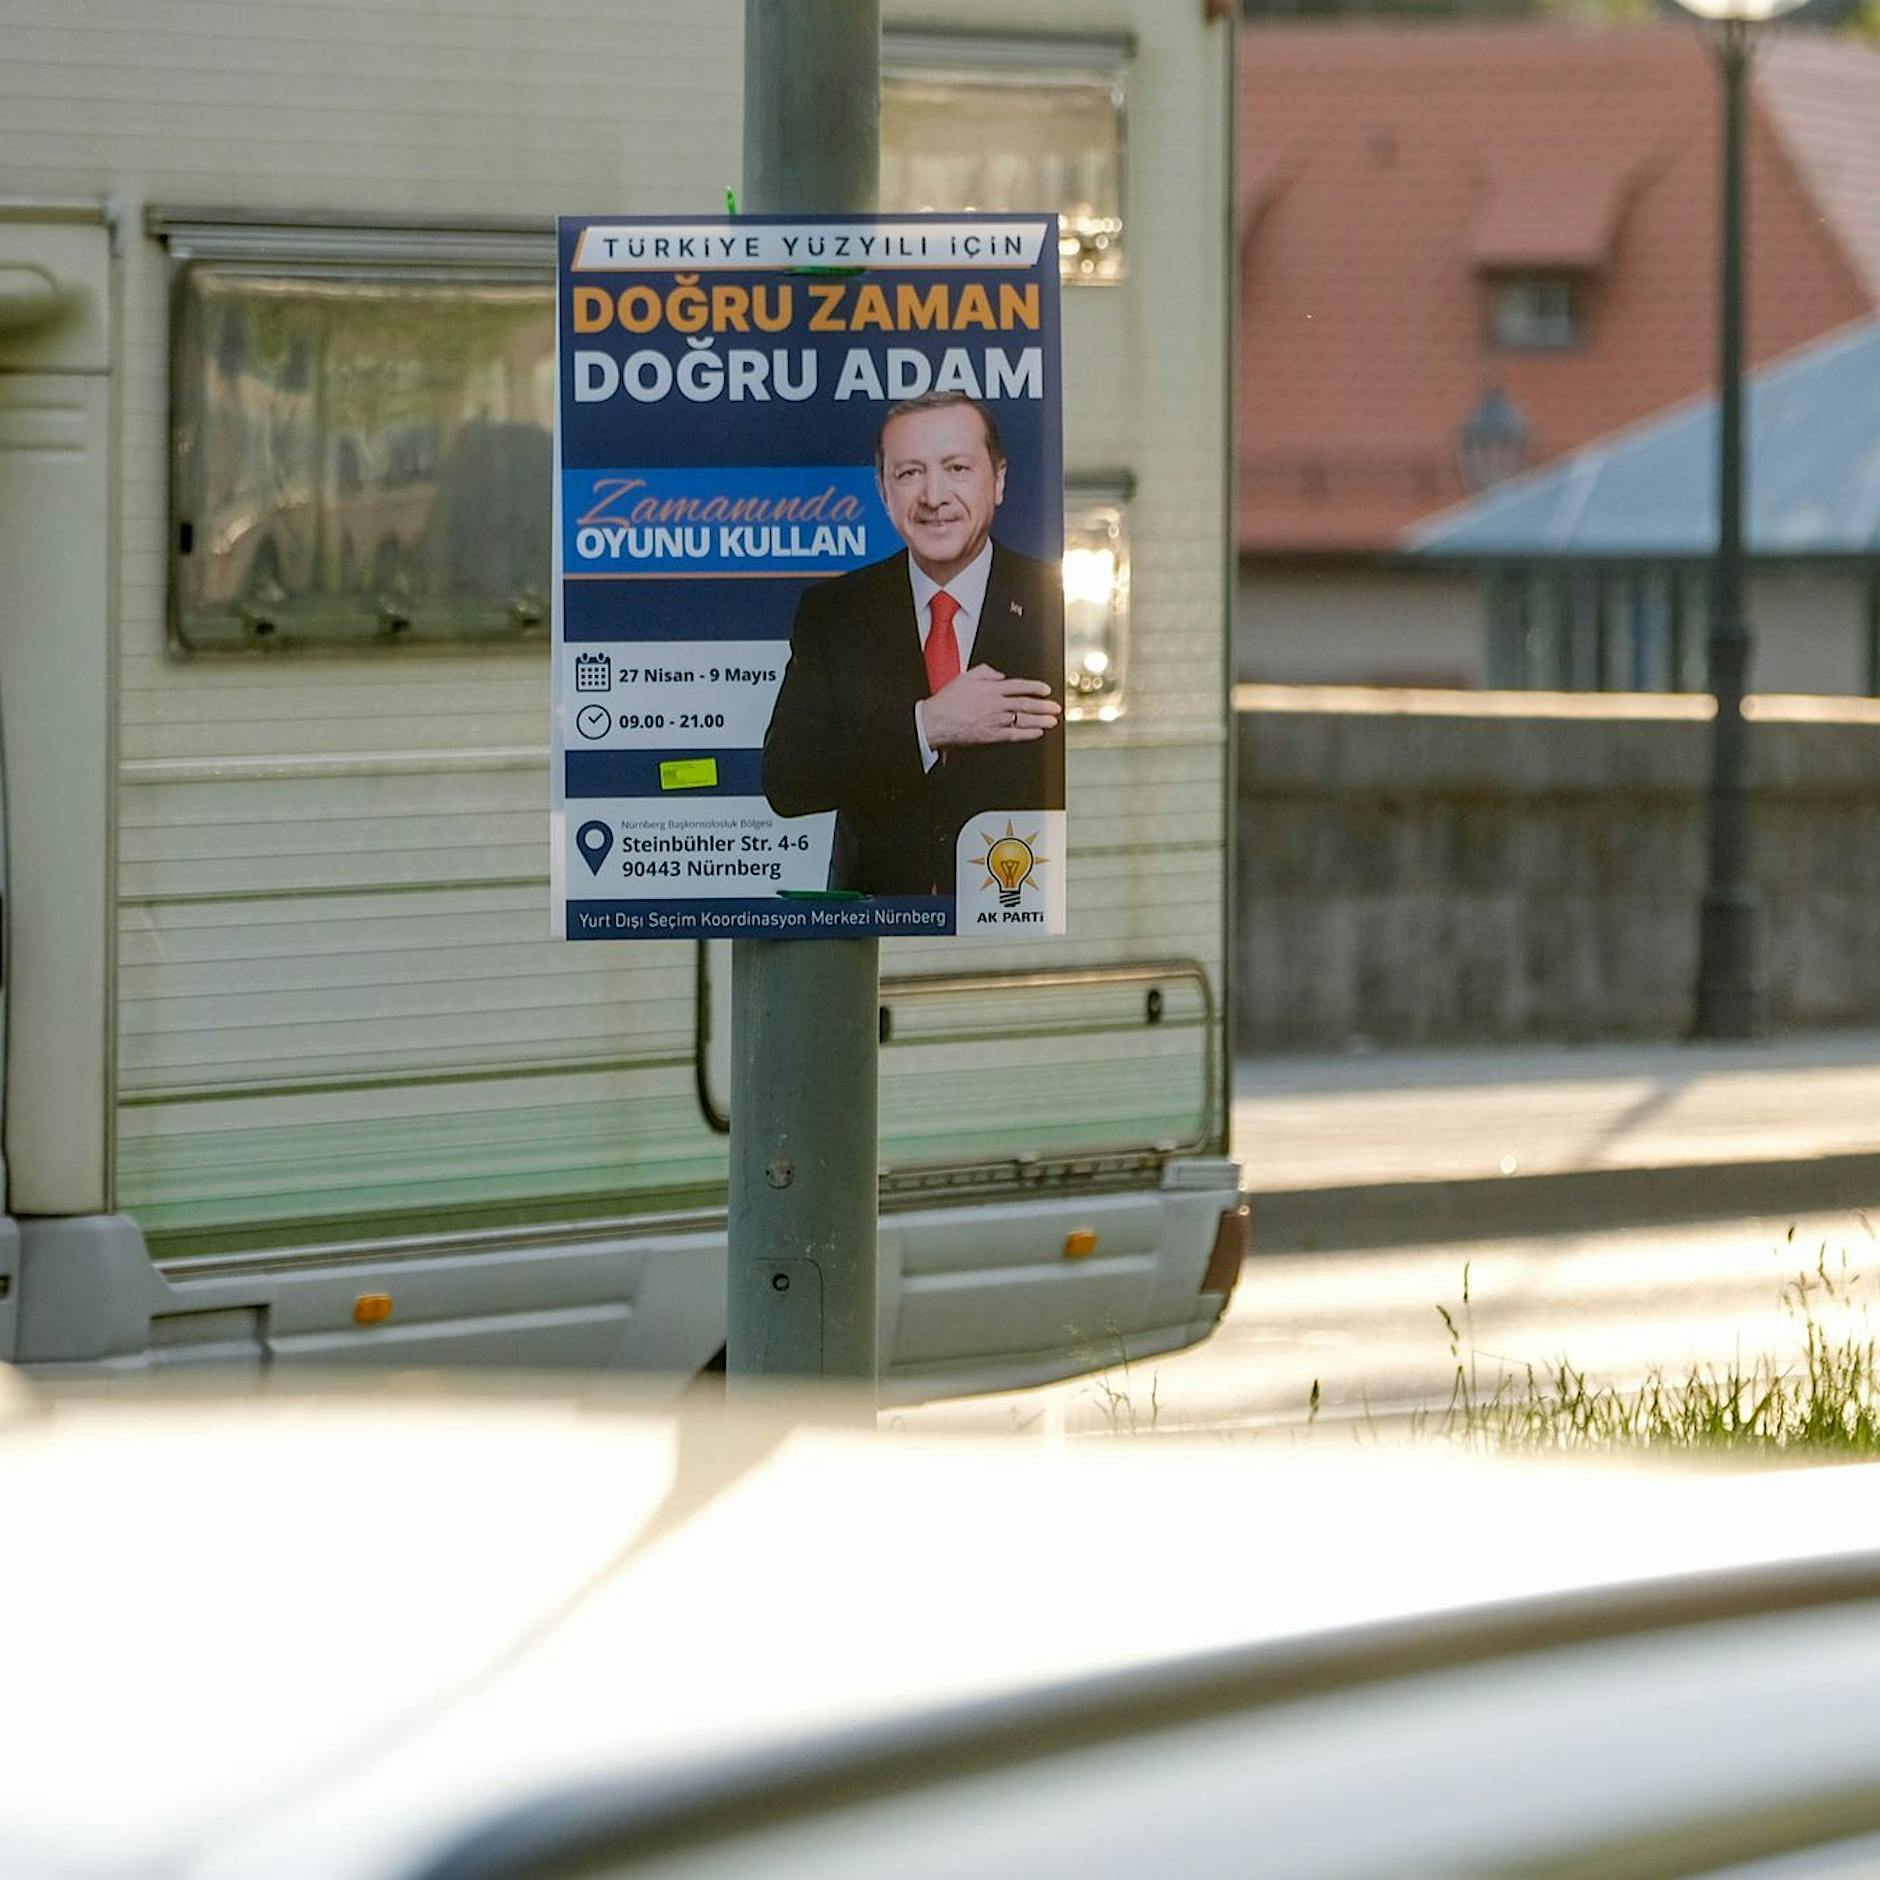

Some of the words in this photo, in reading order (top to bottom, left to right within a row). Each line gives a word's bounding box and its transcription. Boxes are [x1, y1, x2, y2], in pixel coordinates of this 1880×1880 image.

[603, 237, 760, 258] TÜRKİYE
[782, 236, 927, 257] YÜZYILI
[573, 273, 792, 333] DOĞRU
[808, 283, 1041, 331] ZAMAN
[574, 336, 818, 403] DOĞRU
[834, 347, 1044, 400] ADAM
[576, 478, 865, 528] Zamanında
[576, 526, 710, 559] OYUNU
[720, 525, 866, 557] KULLAN
[619, 669, 639, 682] 27
[644, 668, 694, 682] Nisan
[710, 668, 720, 682] 9
[725, 668, 777, 686] Mayıs
[619, 714, 664, 728] 09.00
[679, 714, 725, 728] 21.00
[622, 836, 735, 853] Steinbühler
[741, 836, 772, 851] Str.
[778, 835, 809, 850] 4-6
[622, 861, 681, 877] 90443
[687, 859, 782, 880] Nürnberg
[579, 912, 610, 928] Yurt
[615, 912, 644, 929] Dışı
[649, 911, 697, 929] Seçim
[701, 911, 807, 928] Koordinasyon
[811, 911, 870, 926] Merkezi
[874, 908, 946, 926] Nürnberg
[977, 912, 998, 923] AK
